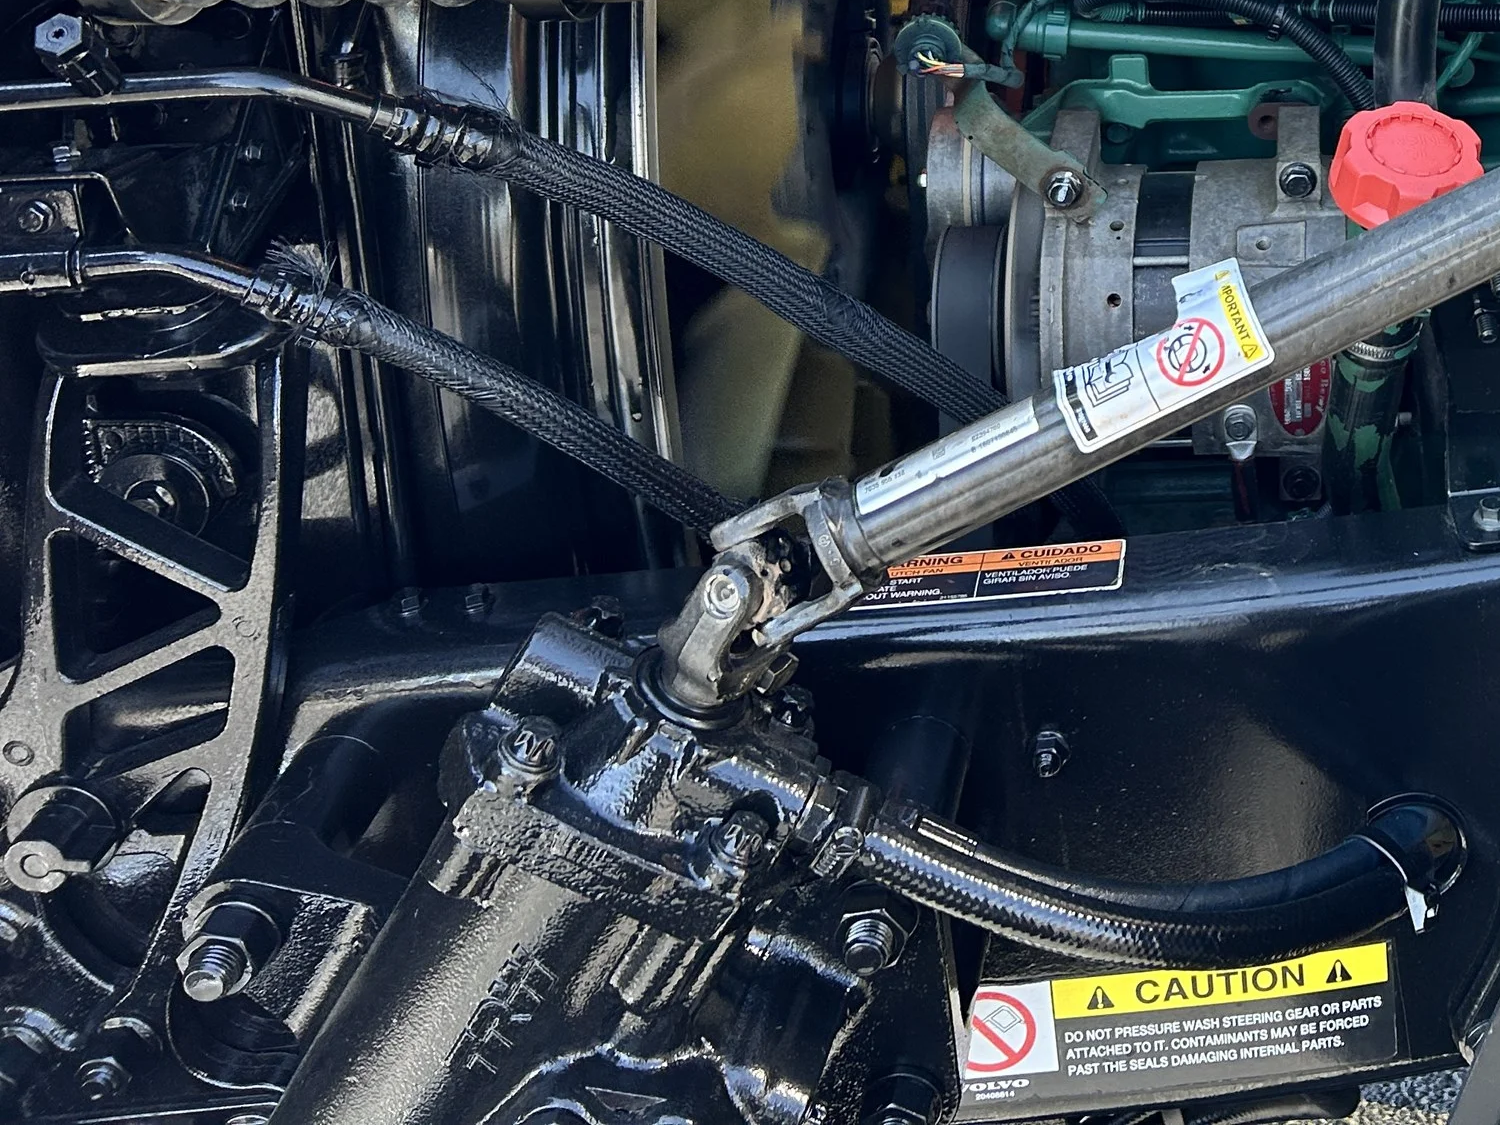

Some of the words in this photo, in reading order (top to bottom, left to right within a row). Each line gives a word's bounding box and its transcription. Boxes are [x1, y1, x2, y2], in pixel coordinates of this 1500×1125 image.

[1020, 544, 1102, 559] CUIDADO
[895, 556, 963, 568] ARNING
[984, 566, 1049, 579] VENTILADOR
[1049, 564, 1088, 573] PUEDE
[889, 577, 923, 586] START
[983, 575, 1017, 585] GIRAR
[1018, 574, 1036, 583] SIN
[891, 588, 943, 599] WARNING.
[1135, 963, 1305, 1004] CAUTION
[1065, 1031, 1084, 1044] DO
[1086, 1029, 1113, 1043] NOT
[1115, 1022, 1181, 1040] PRESSURE
[1183, 1017, 1220, 1033] WASH
[1222, 1011, 1284, 1028] STEERING
[1285, 1005, 1319, 1021] GEAR
[1321, 1003, 1340, 1016] OR
[1341, 995, 1382, 1013] PARTS
[1066, 1043, 1132, 1060] ATTACHED
[1135, 1041, 1151, 1053] TO
[1153, 1039, 1169, 1052] IT.
[1171, 1030, 1268, 1050] CONTAMINANTS
[1270, 1026, 1298, 1040] MAY
[1300, 1023, 1317, 1036] BE
[1319, 1015, 1369, 1034] FORCED
[1068, 1063, 1099, 1076] PAST
[1102, 1060, 1128, 1073] THE
[1129, 1056, 1168, 1071] SEALS
[1171, 1049, 1238, 1067] DAMAGING
[1239, 1042, 1299, 1060] INTERNAL
[1301, 1035, 1345, 1053] PARTS.
